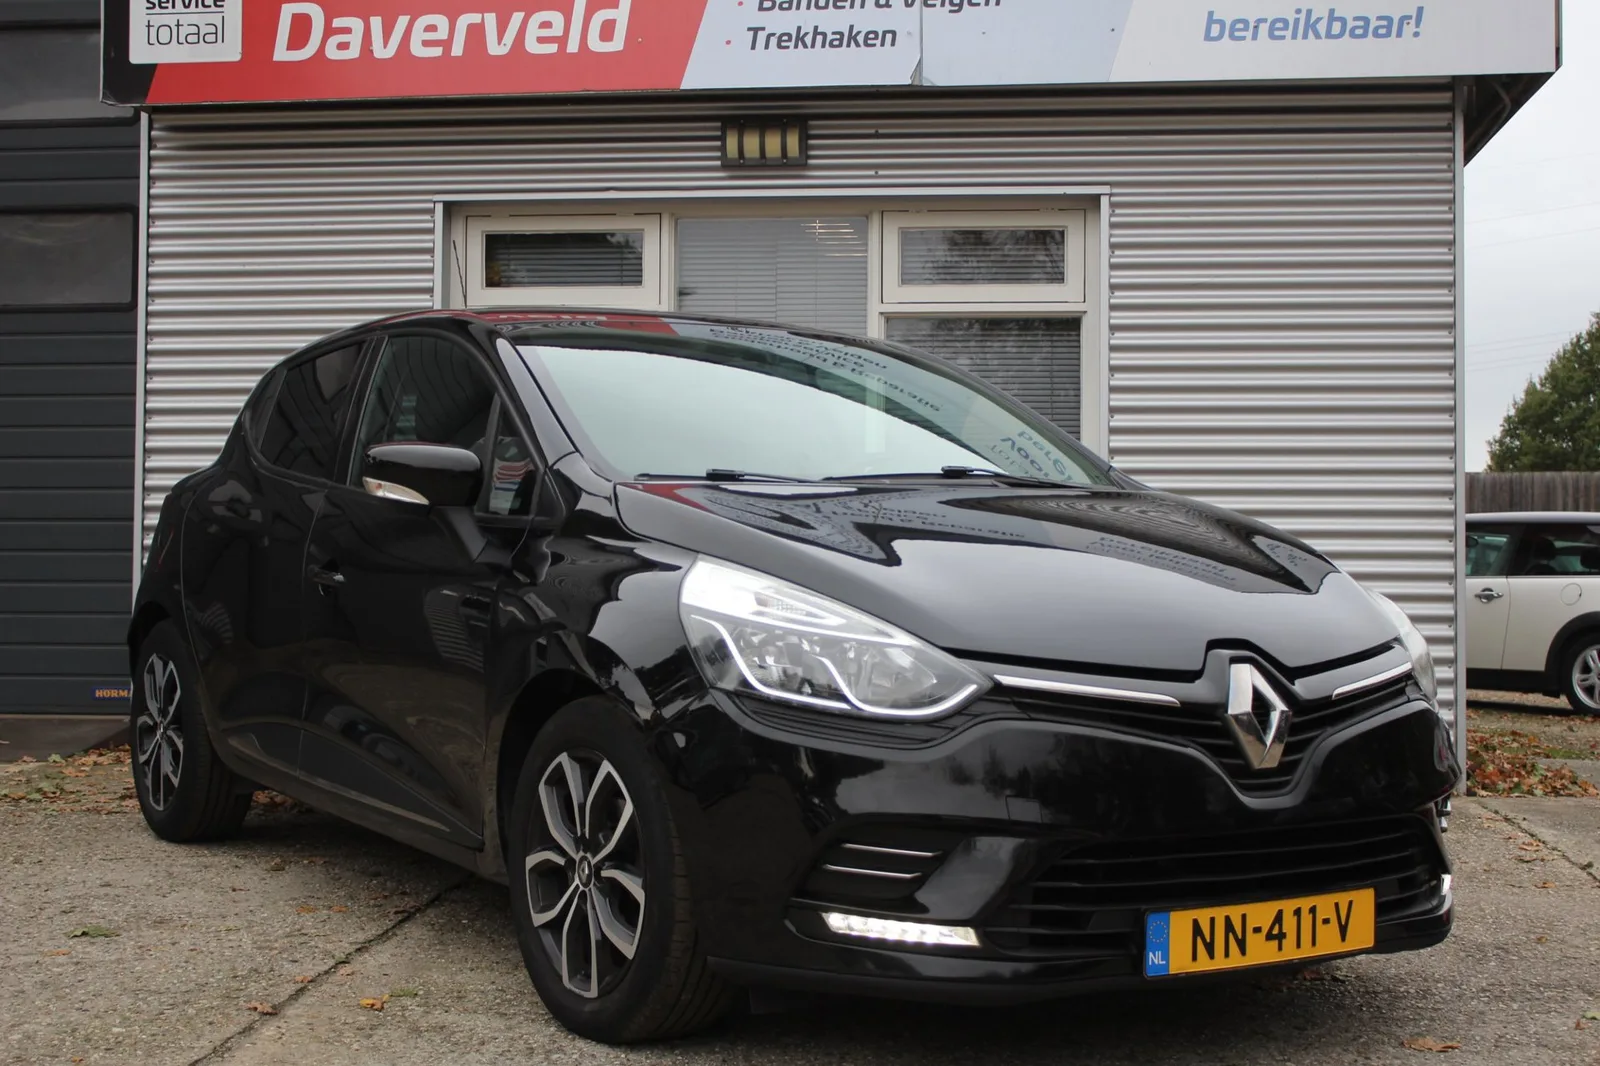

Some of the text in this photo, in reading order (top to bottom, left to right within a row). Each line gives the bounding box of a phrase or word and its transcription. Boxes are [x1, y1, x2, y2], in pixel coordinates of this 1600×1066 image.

[145, 15, 225, 46] totaal
[272, 0, 631, 62] Daverveld
[747, 24, 897, 51] Trekhaken
[1203, 6, 1425, 42] bereikbaar!
[1191, 899, 1354, 963] NN-411-V
[1149, 951, 1166, 966] NL
